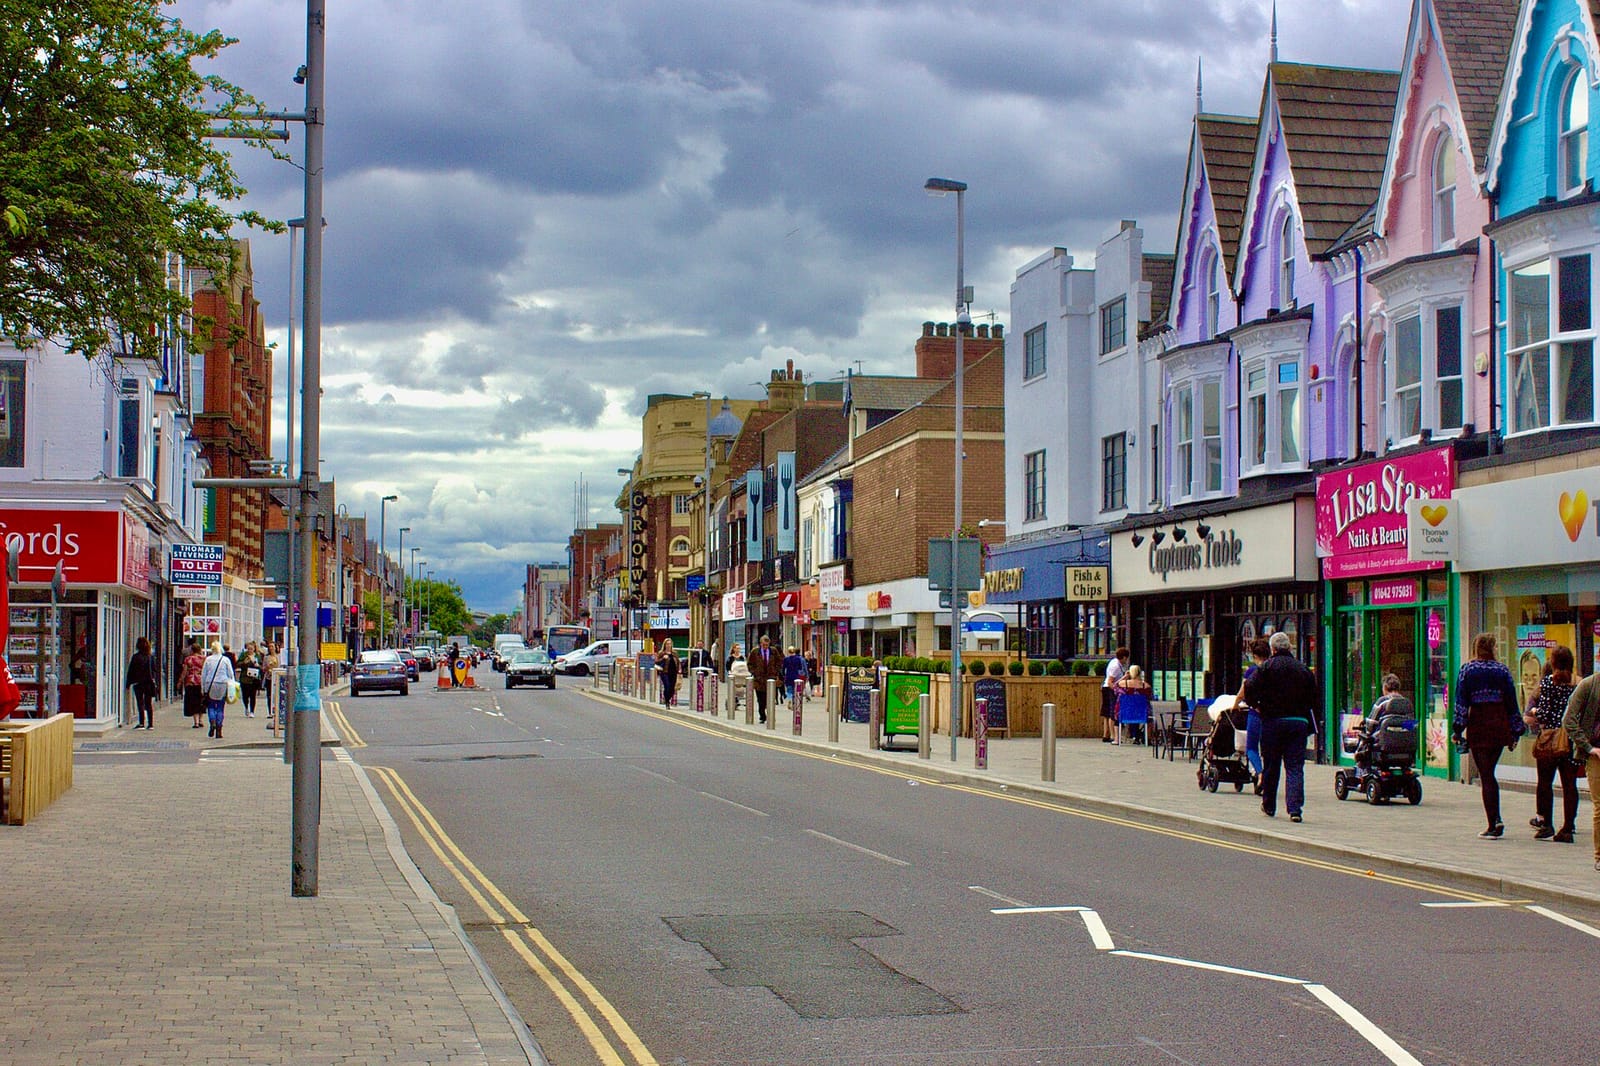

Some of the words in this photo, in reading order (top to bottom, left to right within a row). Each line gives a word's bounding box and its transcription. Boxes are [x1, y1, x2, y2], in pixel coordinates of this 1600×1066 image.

[1330, 472, 1379, 539] Lisa
[1348, 529, 1370, 549] Nails
[1371, 527, 1379, 545] &
[1380, 525, 1407, 546] Beauty
[1421, 528, 1449, 536] Thomas
[180, 545, 215, 553] THOMAS
[1202, 529, 1242, 569] Table
[173, 552, 222, 560] STEVENSON
[180, 561, 194, 570] TO
[196, 562, 215, 571] LET
[1072, 570, 1093, 582] Fish
[1093, 571, 1102, 581] &
[1072, 584, 1102, 600] Chips
[1373, 586, 1391, 600] 01642
[830, 596, 851, 604] Bright
